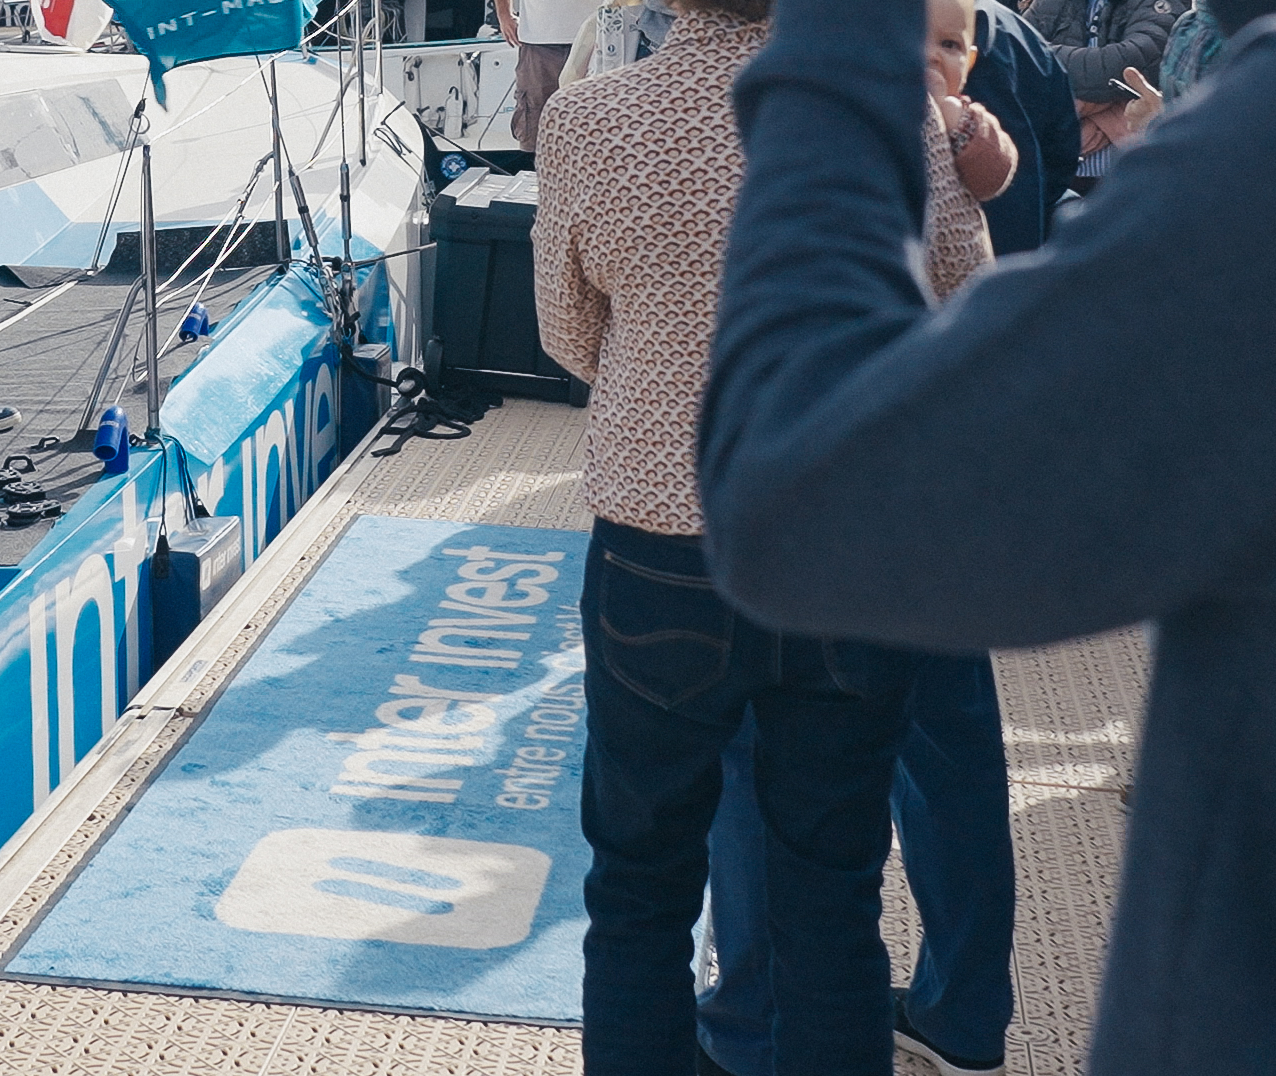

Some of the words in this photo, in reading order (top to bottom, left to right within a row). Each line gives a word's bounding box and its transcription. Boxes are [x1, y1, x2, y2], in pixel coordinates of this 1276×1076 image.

[406, 545, 567, 669] invest
[325, 674, 503, 804] inter
[494, 745, 567, 810] entre
